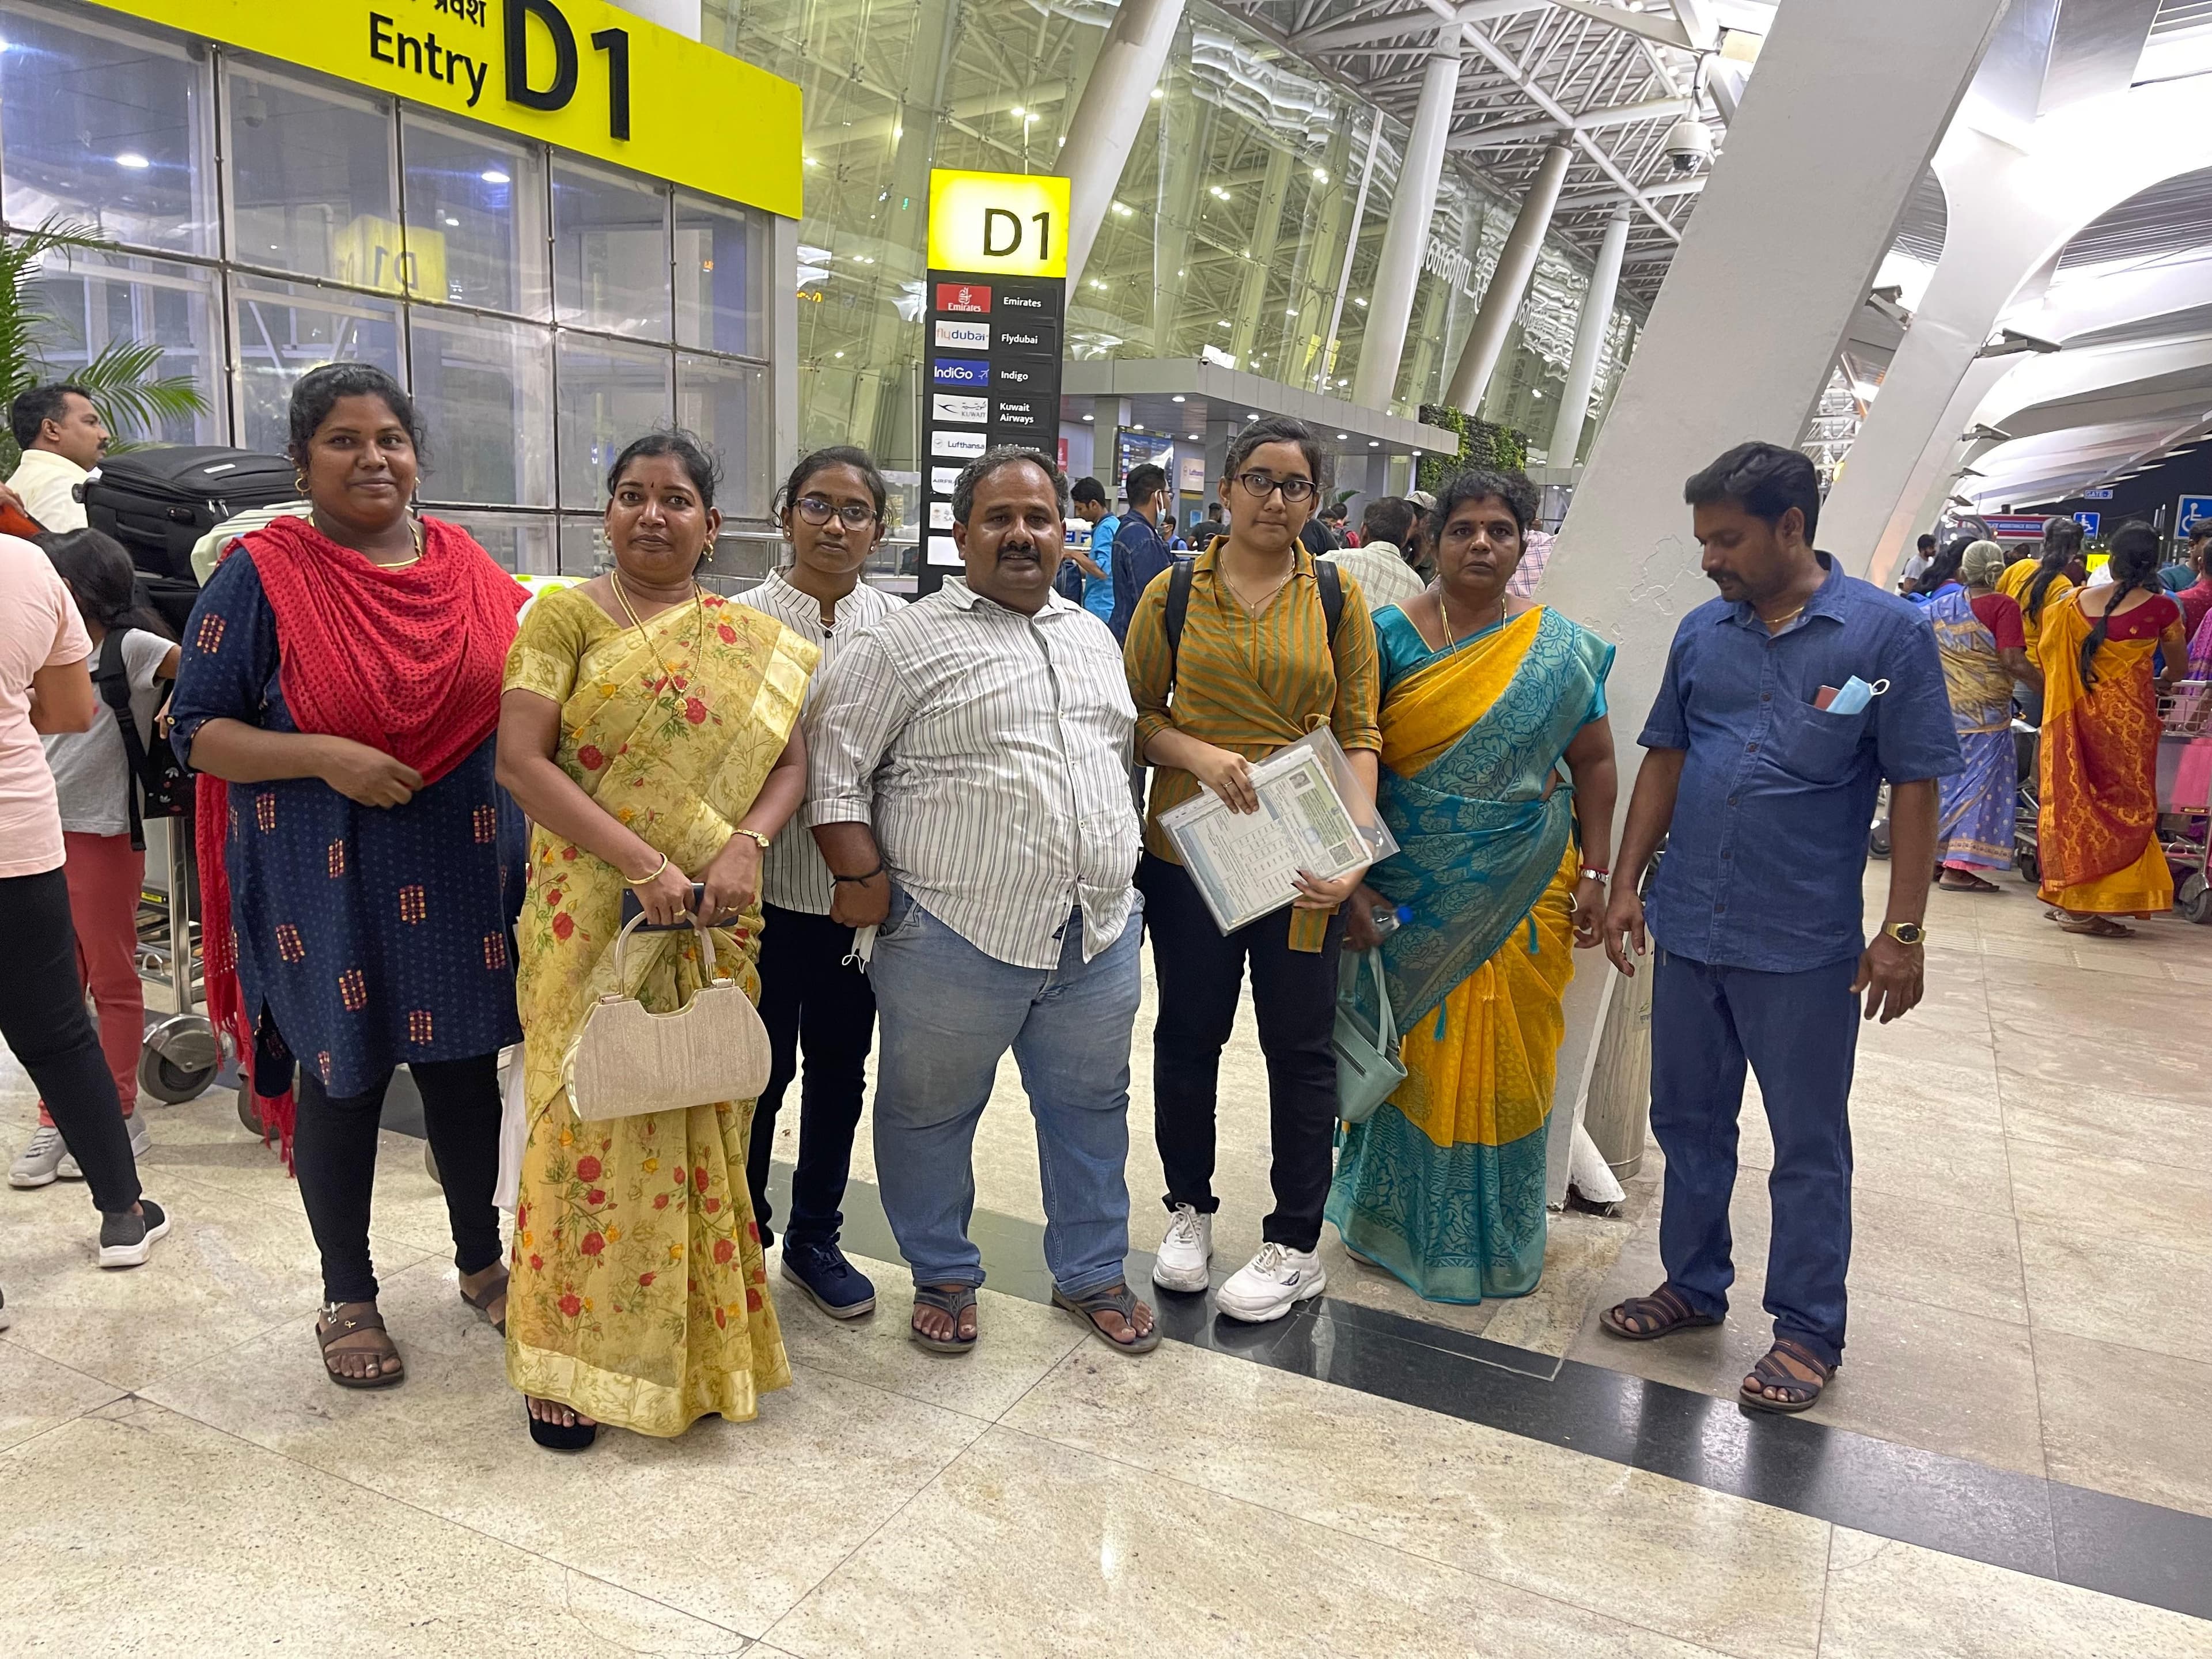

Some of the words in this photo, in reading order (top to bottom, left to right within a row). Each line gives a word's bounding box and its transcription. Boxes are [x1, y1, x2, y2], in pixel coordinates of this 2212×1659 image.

[369, 11, 488, 107] Entry
[504, 0, 631, 142] D1
[983, 207, 1050, 260] D1
[948, 302, 982, 313] Emirates
[1003, 297, 1042, 308] Emirates
[936, 327, 986, 342] flydubai
[1001, 333, 1038, 345] Flydubai
[934, 366, 974, 380] IndiGo
[1001, 370, 1029, 382] Indigo
[999, 402, 1030, 412] Kuwait
[999, 414, 1035, 425] Airways
[947, 440, 985, 450] Lufthansa
